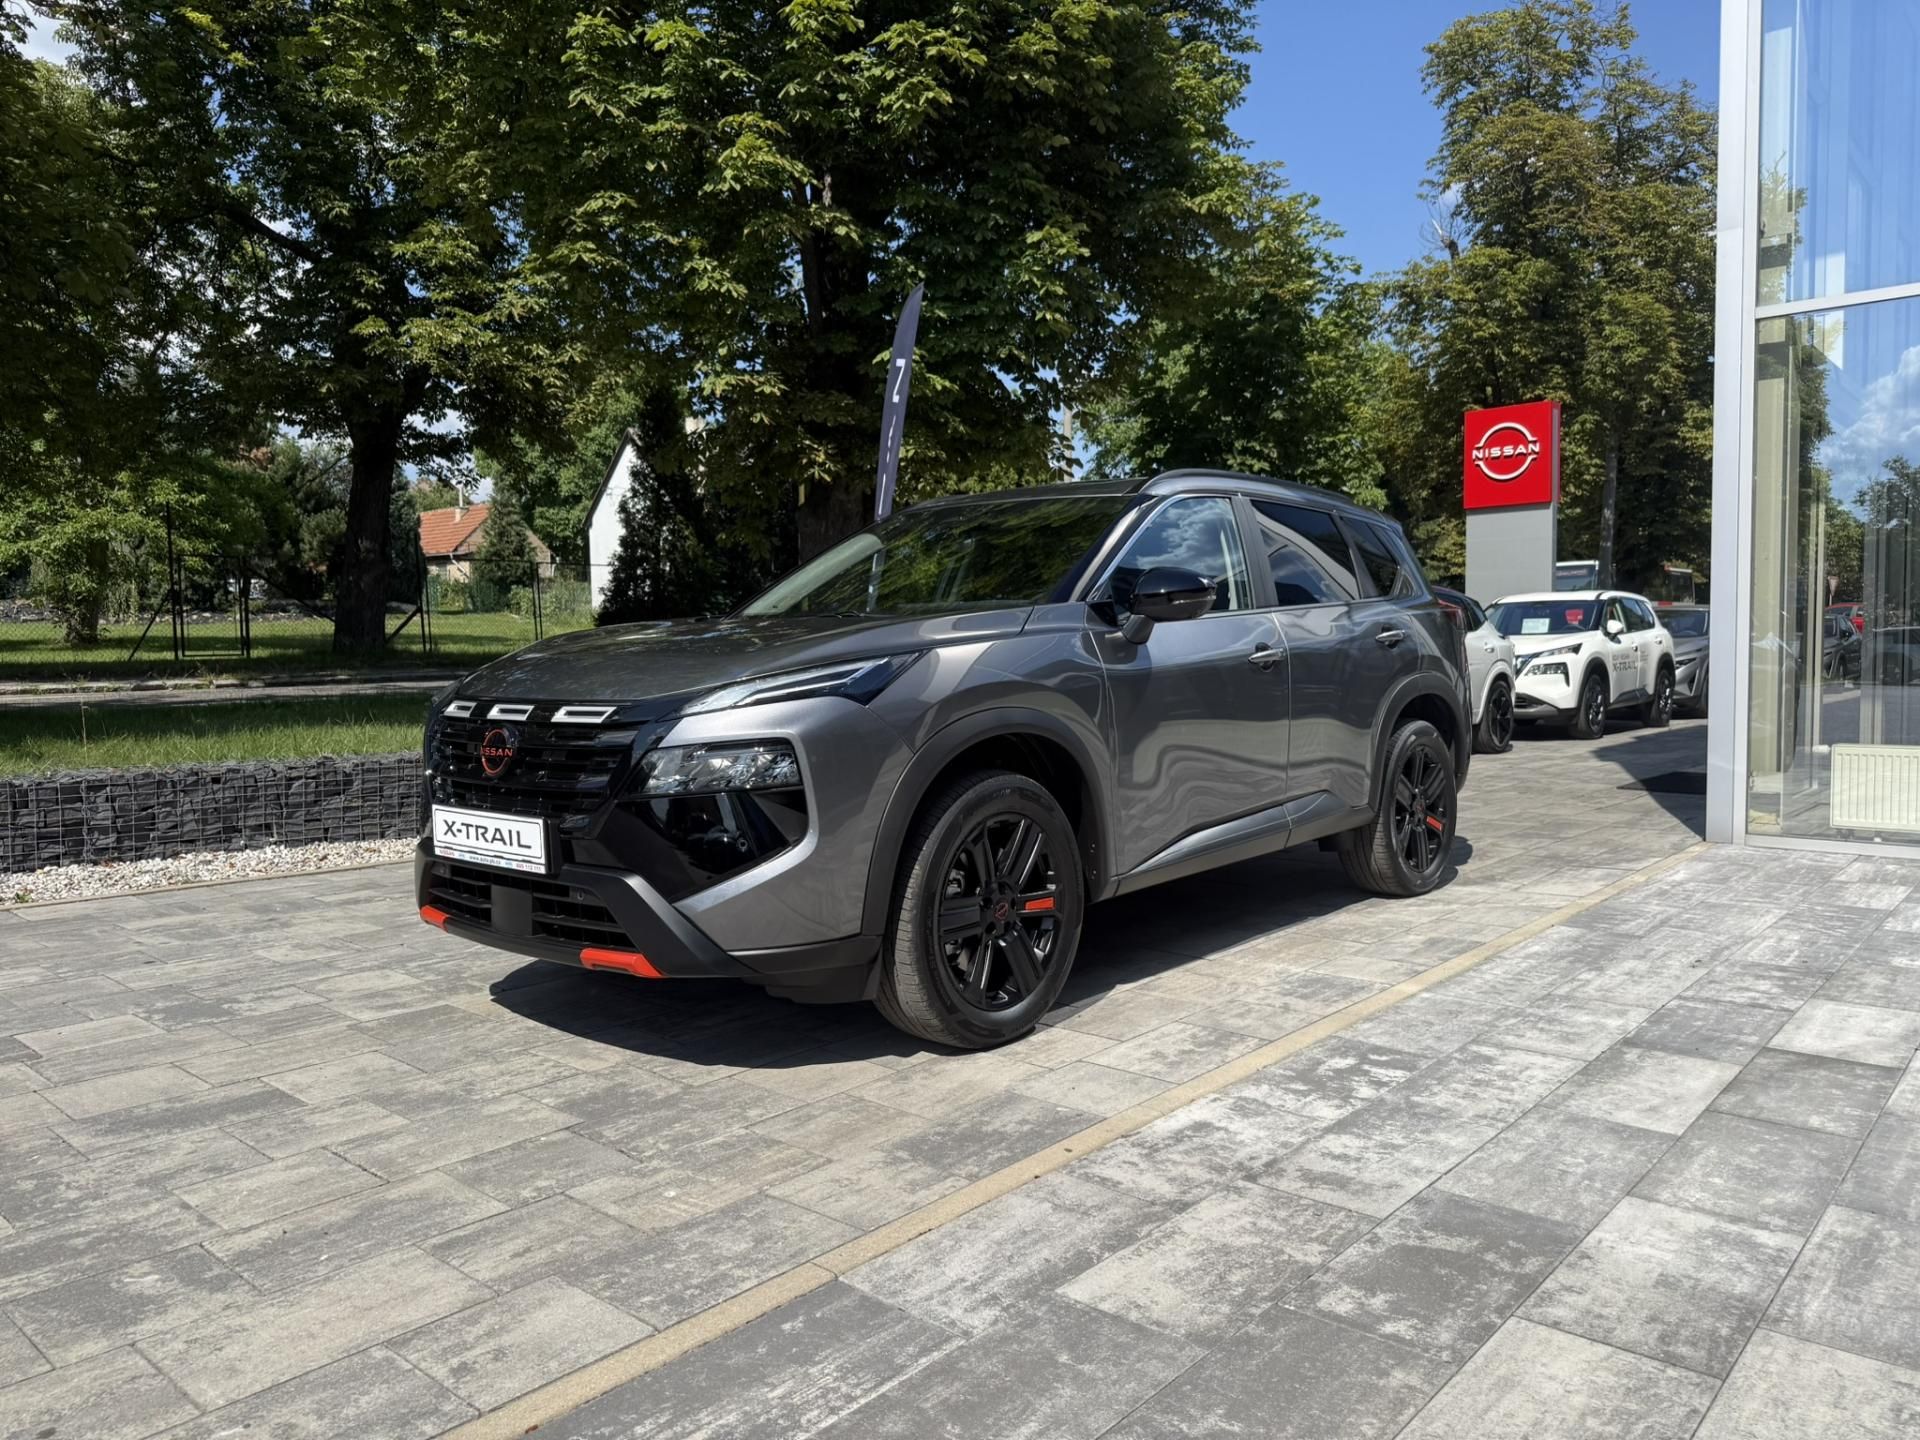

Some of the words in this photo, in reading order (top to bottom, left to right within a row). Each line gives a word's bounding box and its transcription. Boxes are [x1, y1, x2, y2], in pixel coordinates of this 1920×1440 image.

[1472, 442, 1540, 460] NISSAN
[481, 747, 513, 757] SSAN
[443, 819, 532, 850] X-TRAIL
